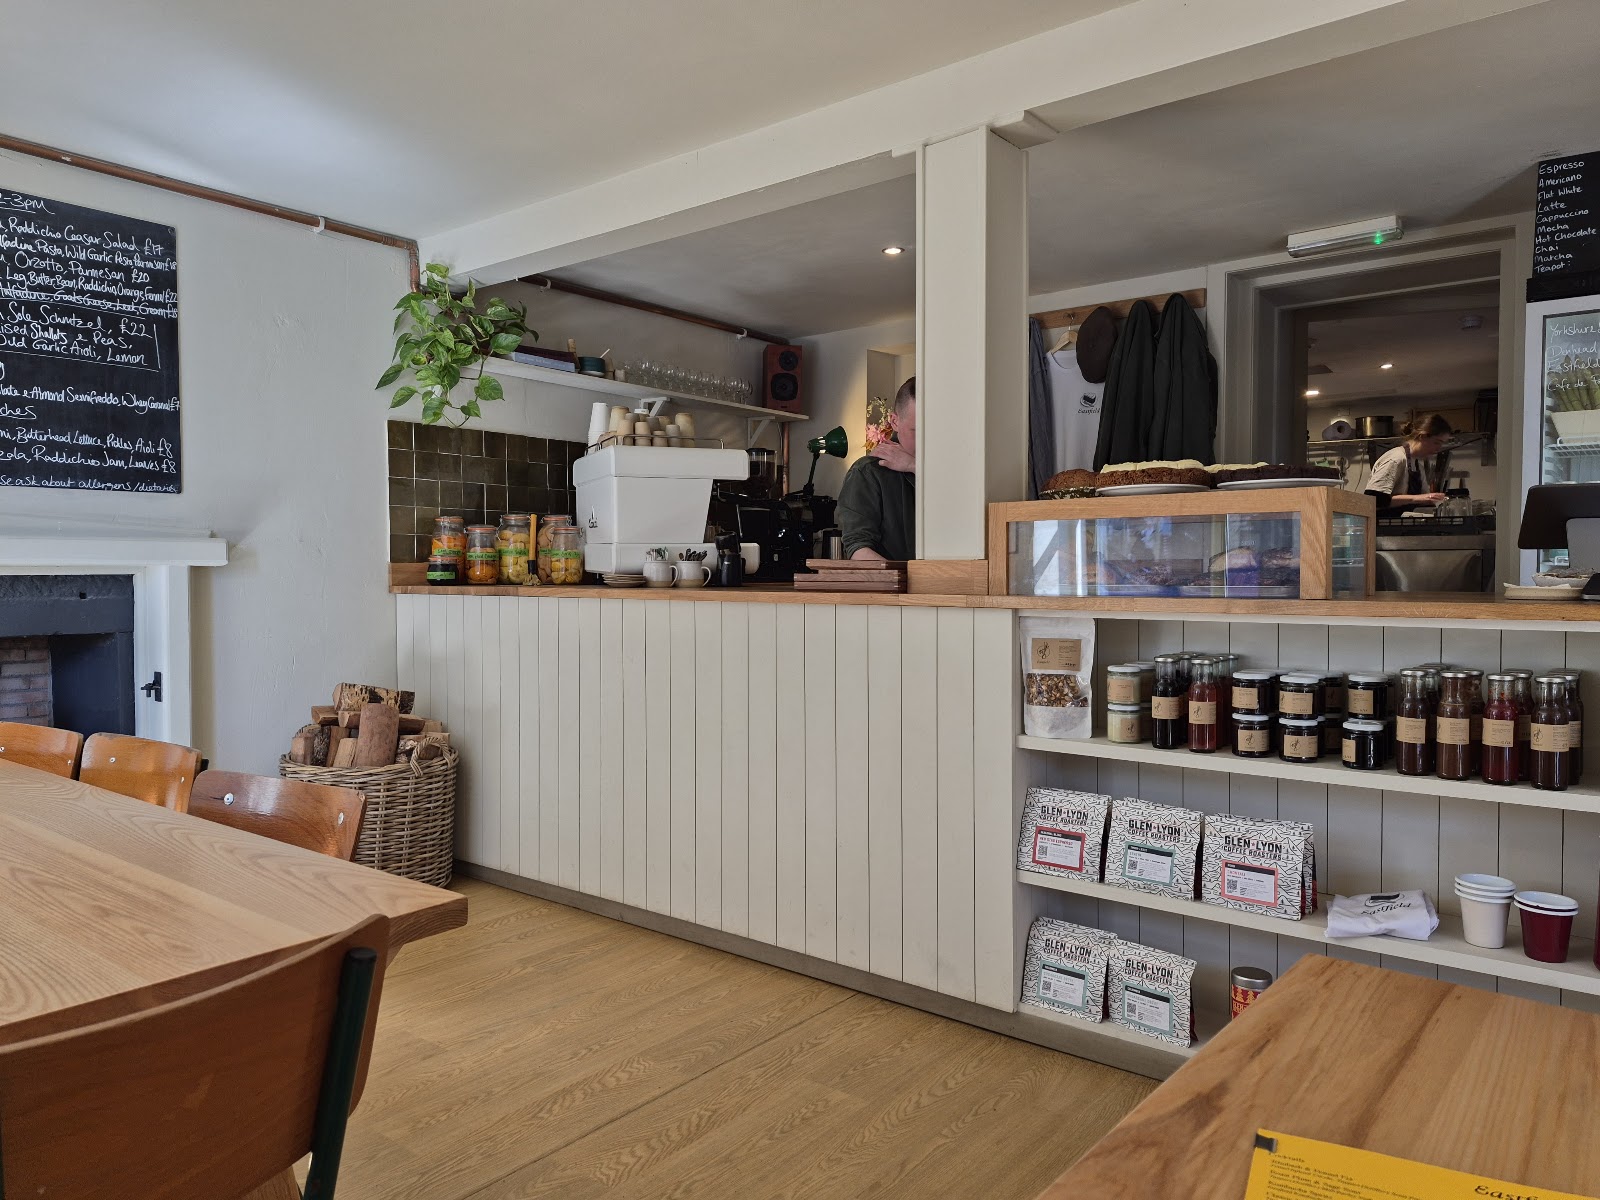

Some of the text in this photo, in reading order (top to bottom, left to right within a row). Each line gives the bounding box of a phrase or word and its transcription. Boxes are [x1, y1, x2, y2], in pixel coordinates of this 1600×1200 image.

[1539, 161, 1585, 174] Espresso
[1538, 174, 1582, 188] Americano
[1537, 186, 1583, 201] Flat White
[1537, 200, 1567, 213] Latte
[1536, 208, 1589, 224] Cappuccino
[1535, 227, 1597, 244] Hot Chocolate
[1537, 223, 1569, 234] Mocha
[102, 231, 140, 251] Salad
[143, 237, 164, 256] £17
[1535, 242, 1559, 254] Chai
[65, 244, 86, 261] Wild
[87, 248, 113, 263] Garlic
[1534, 253, 1573, 263] Matcha
[68, 260, 125, 283] Parmesan
[131, 268, 150, 283] £20
[7, 301, 38, 323] Sole
[119, 317, 153, 339] £22
[1550, 322, 1597, 343] Yorkshire
[32, 339, 70, 354] Garlic
[106, 347, 149, 366] Lemon
[29, 386, 65, 402] Almond
[15, 426, 72, 444] Butterhead
[156, 437, 173, 458] £8
[128, 455, 160, 470] Leaves
[161, 458, 176, 474] £8
[41, 475, 76, 488] about
[1040, 805, 1089, 821] GLEN LYON
[1128, 819, 1181, 837] GLEN LYON
[1224, 835, 1283, 854] GLEN LYON
[1248, 849, 1282, 862] ROASTERS
[1044, 938, 1093, 958] GLEN LYON
[1125, 958, 1174, 979] GLEN LYON
